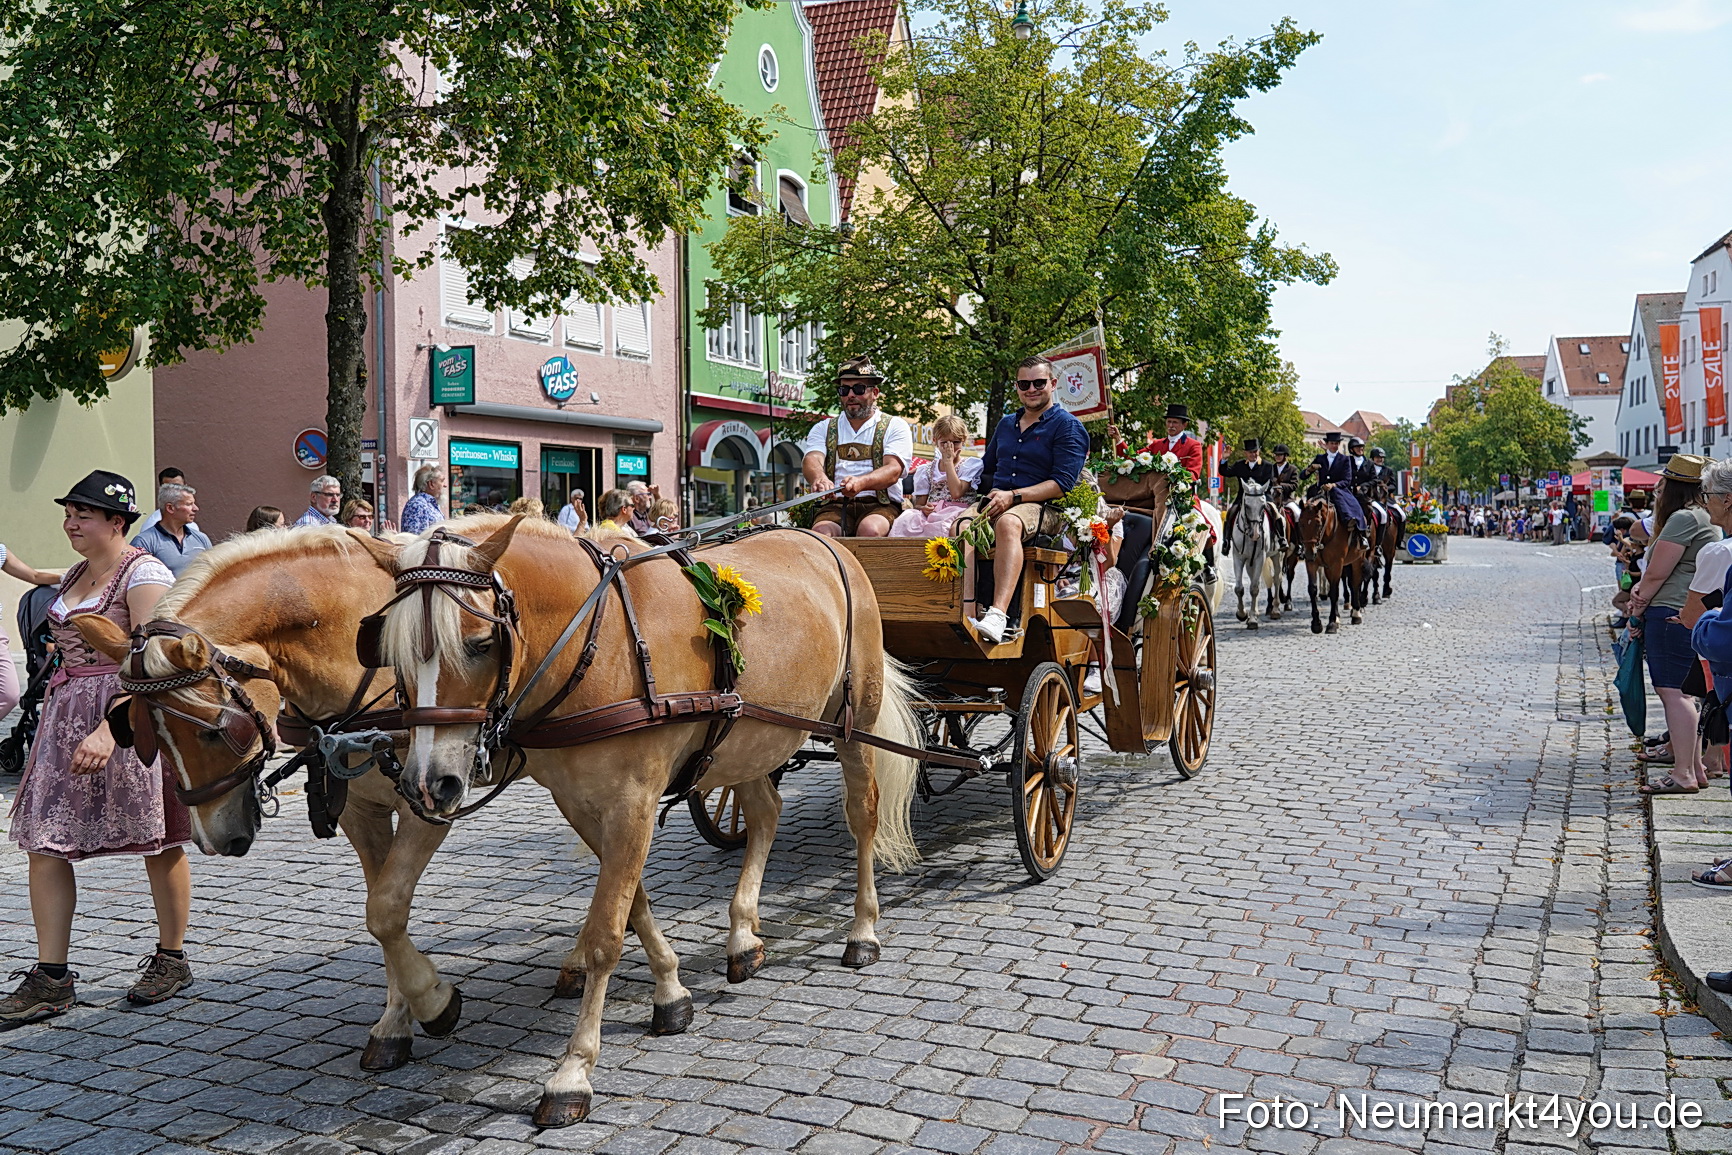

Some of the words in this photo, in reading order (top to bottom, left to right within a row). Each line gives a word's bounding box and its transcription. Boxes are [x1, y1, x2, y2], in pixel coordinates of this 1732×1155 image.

[438, 357, 454, 368] vom
[443, 360, 467, 377] FASS
[541, 361, 562, 378] vom
[1703, 340, 1722, 389] SALE
[547, 371, 578, 396] FASS
[451, 446, 488, 461] Spirituosen
[492, 450, 517, 464] Whisky
